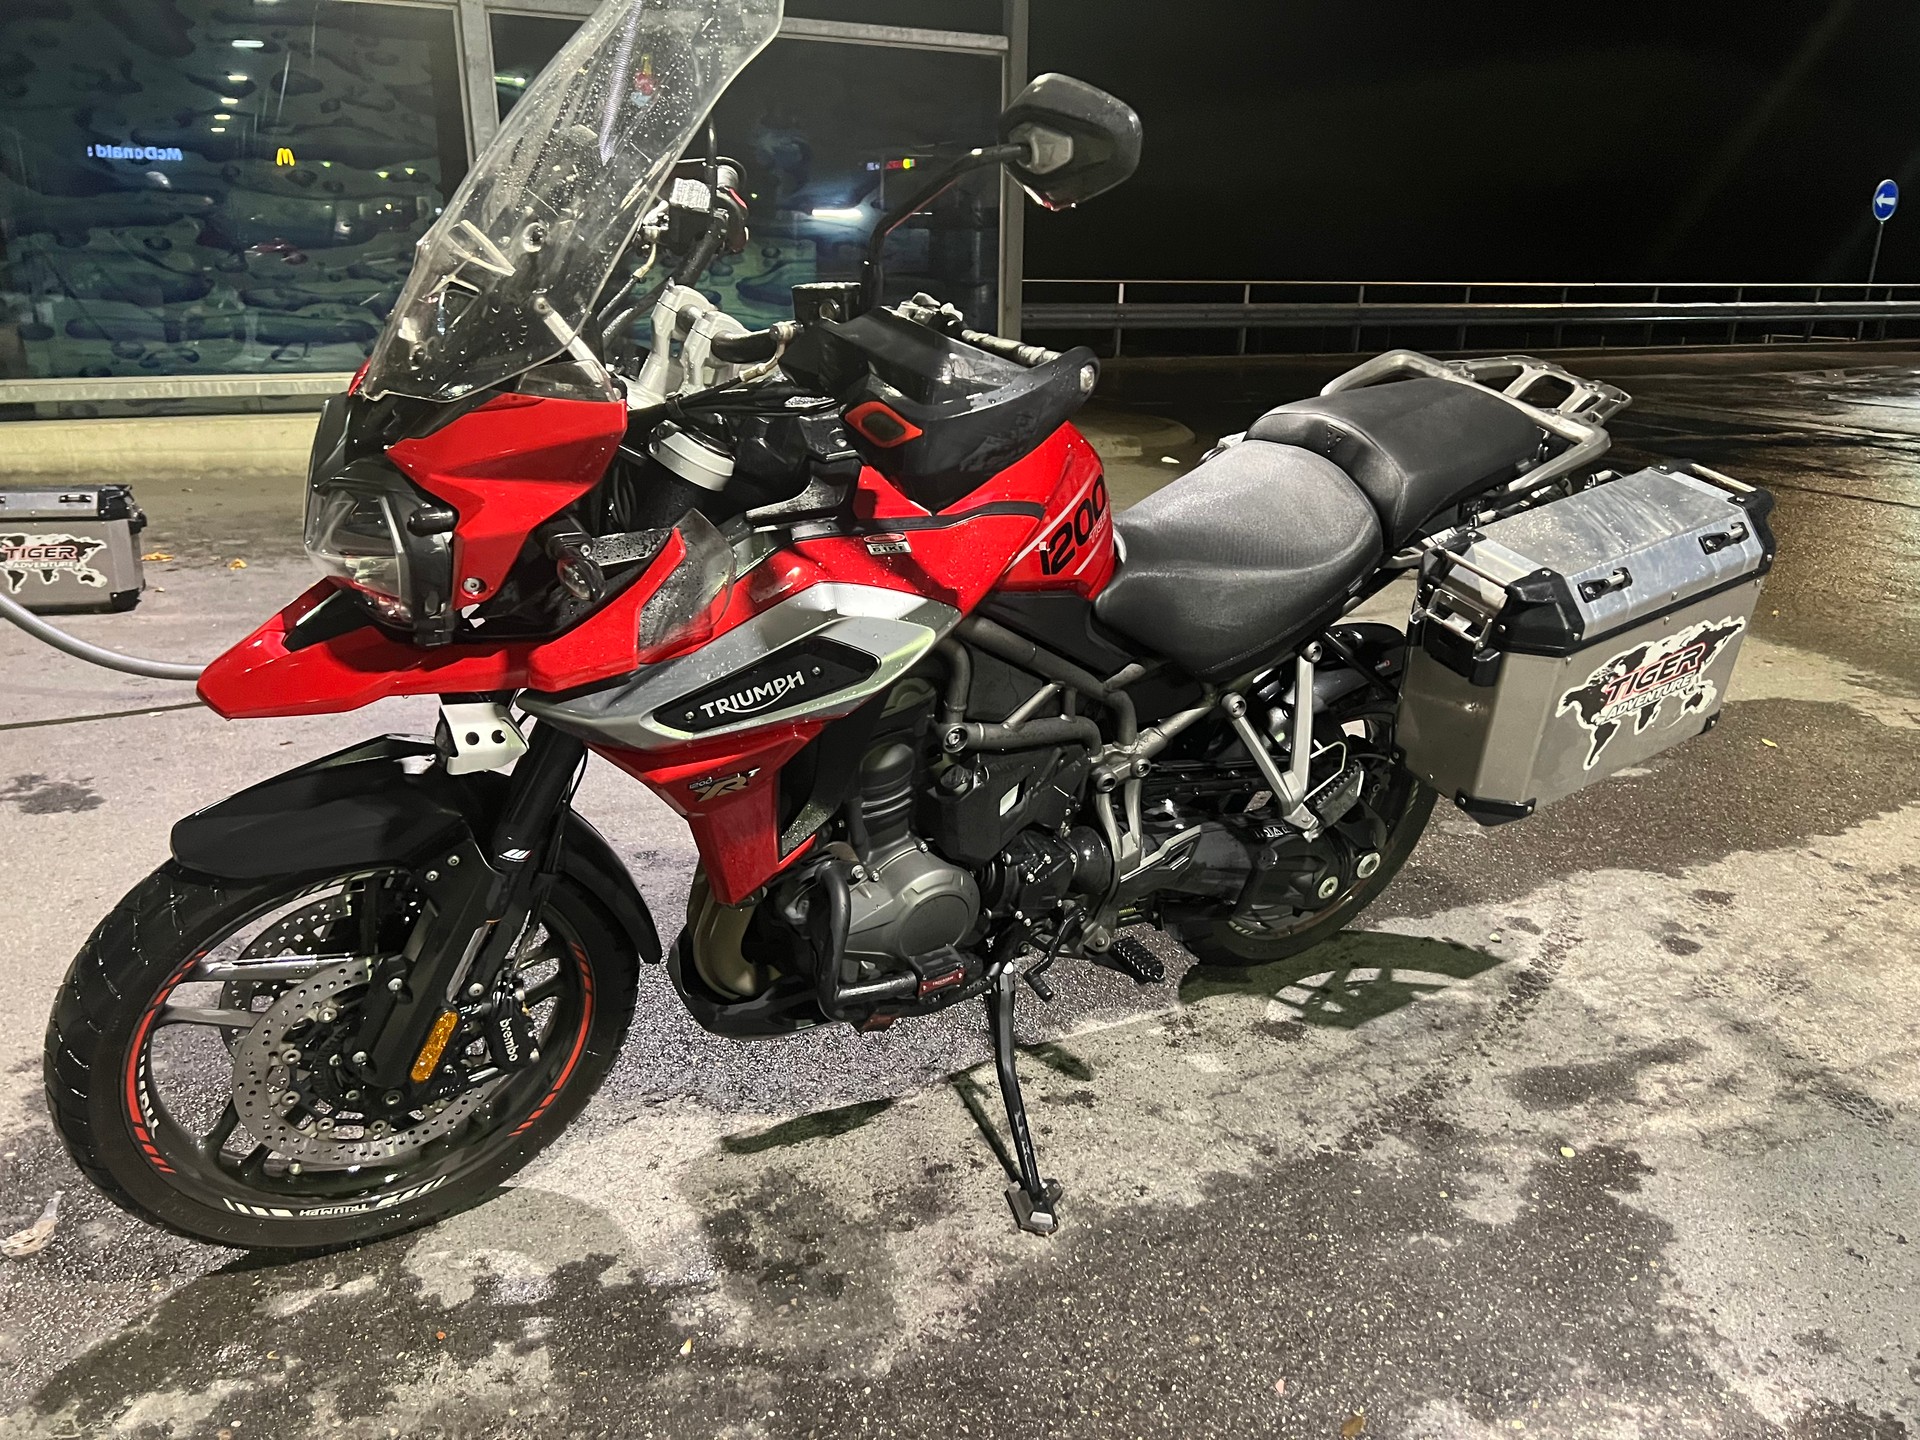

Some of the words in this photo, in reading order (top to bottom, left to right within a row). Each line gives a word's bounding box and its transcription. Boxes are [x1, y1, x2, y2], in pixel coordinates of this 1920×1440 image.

[4, 546, 78, 560] TIGER
[700, 671, 805, 718] TRIUMPH
[1605, 671, 1695, 722] ADVENTURE
[1606, 644, 1706, 704] TIGER
[499, 1017, 520, 1062] brembo
[299, 1203, 370, 1217] TRIUMPH
